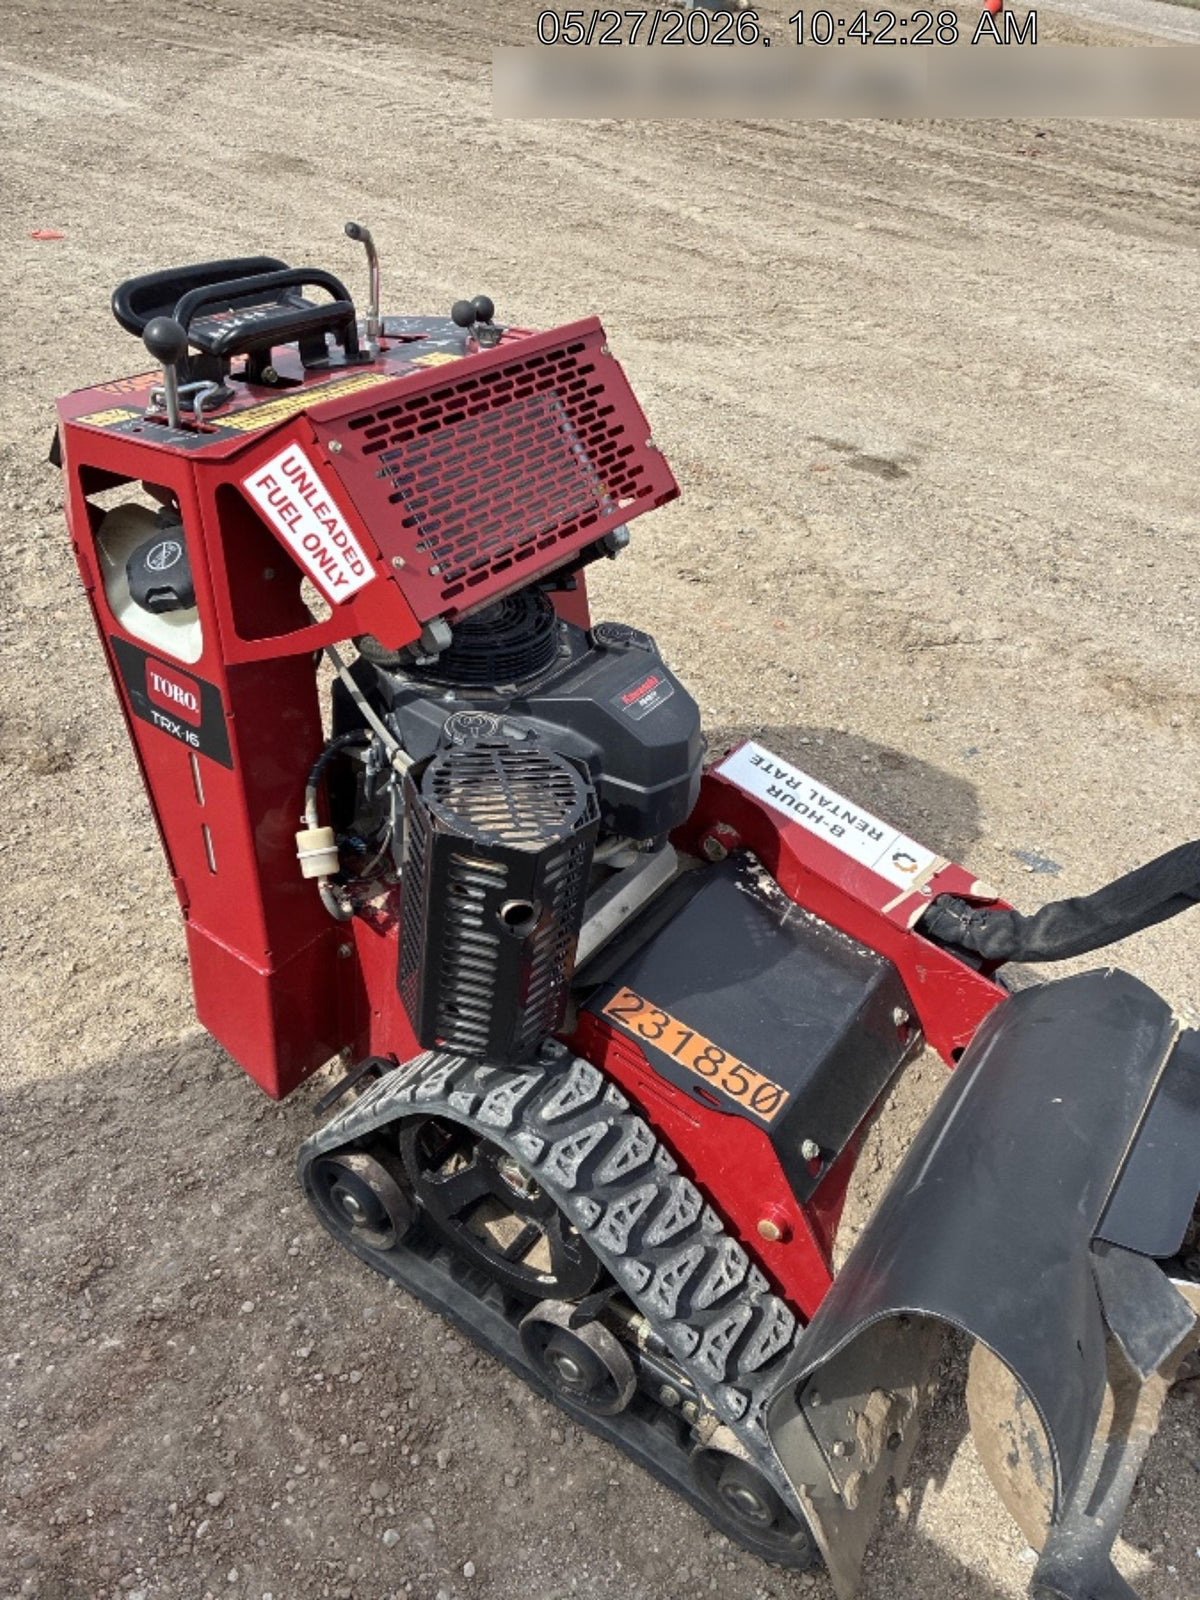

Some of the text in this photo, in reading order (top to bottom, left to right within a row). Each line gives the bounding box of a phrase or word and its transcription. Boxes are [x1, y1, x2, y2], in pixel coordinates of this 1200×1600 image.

[256, 473, 349, 589] FUEL ONLY
[280, 455, 366, 577] UNLEADED
[150, 672, 197, 710] TORO
[151, 710, 200, 748] TRX-16
[748, 753, 884, 842] RENTAL RATE
[606, 993, 784, 1114] 231850
